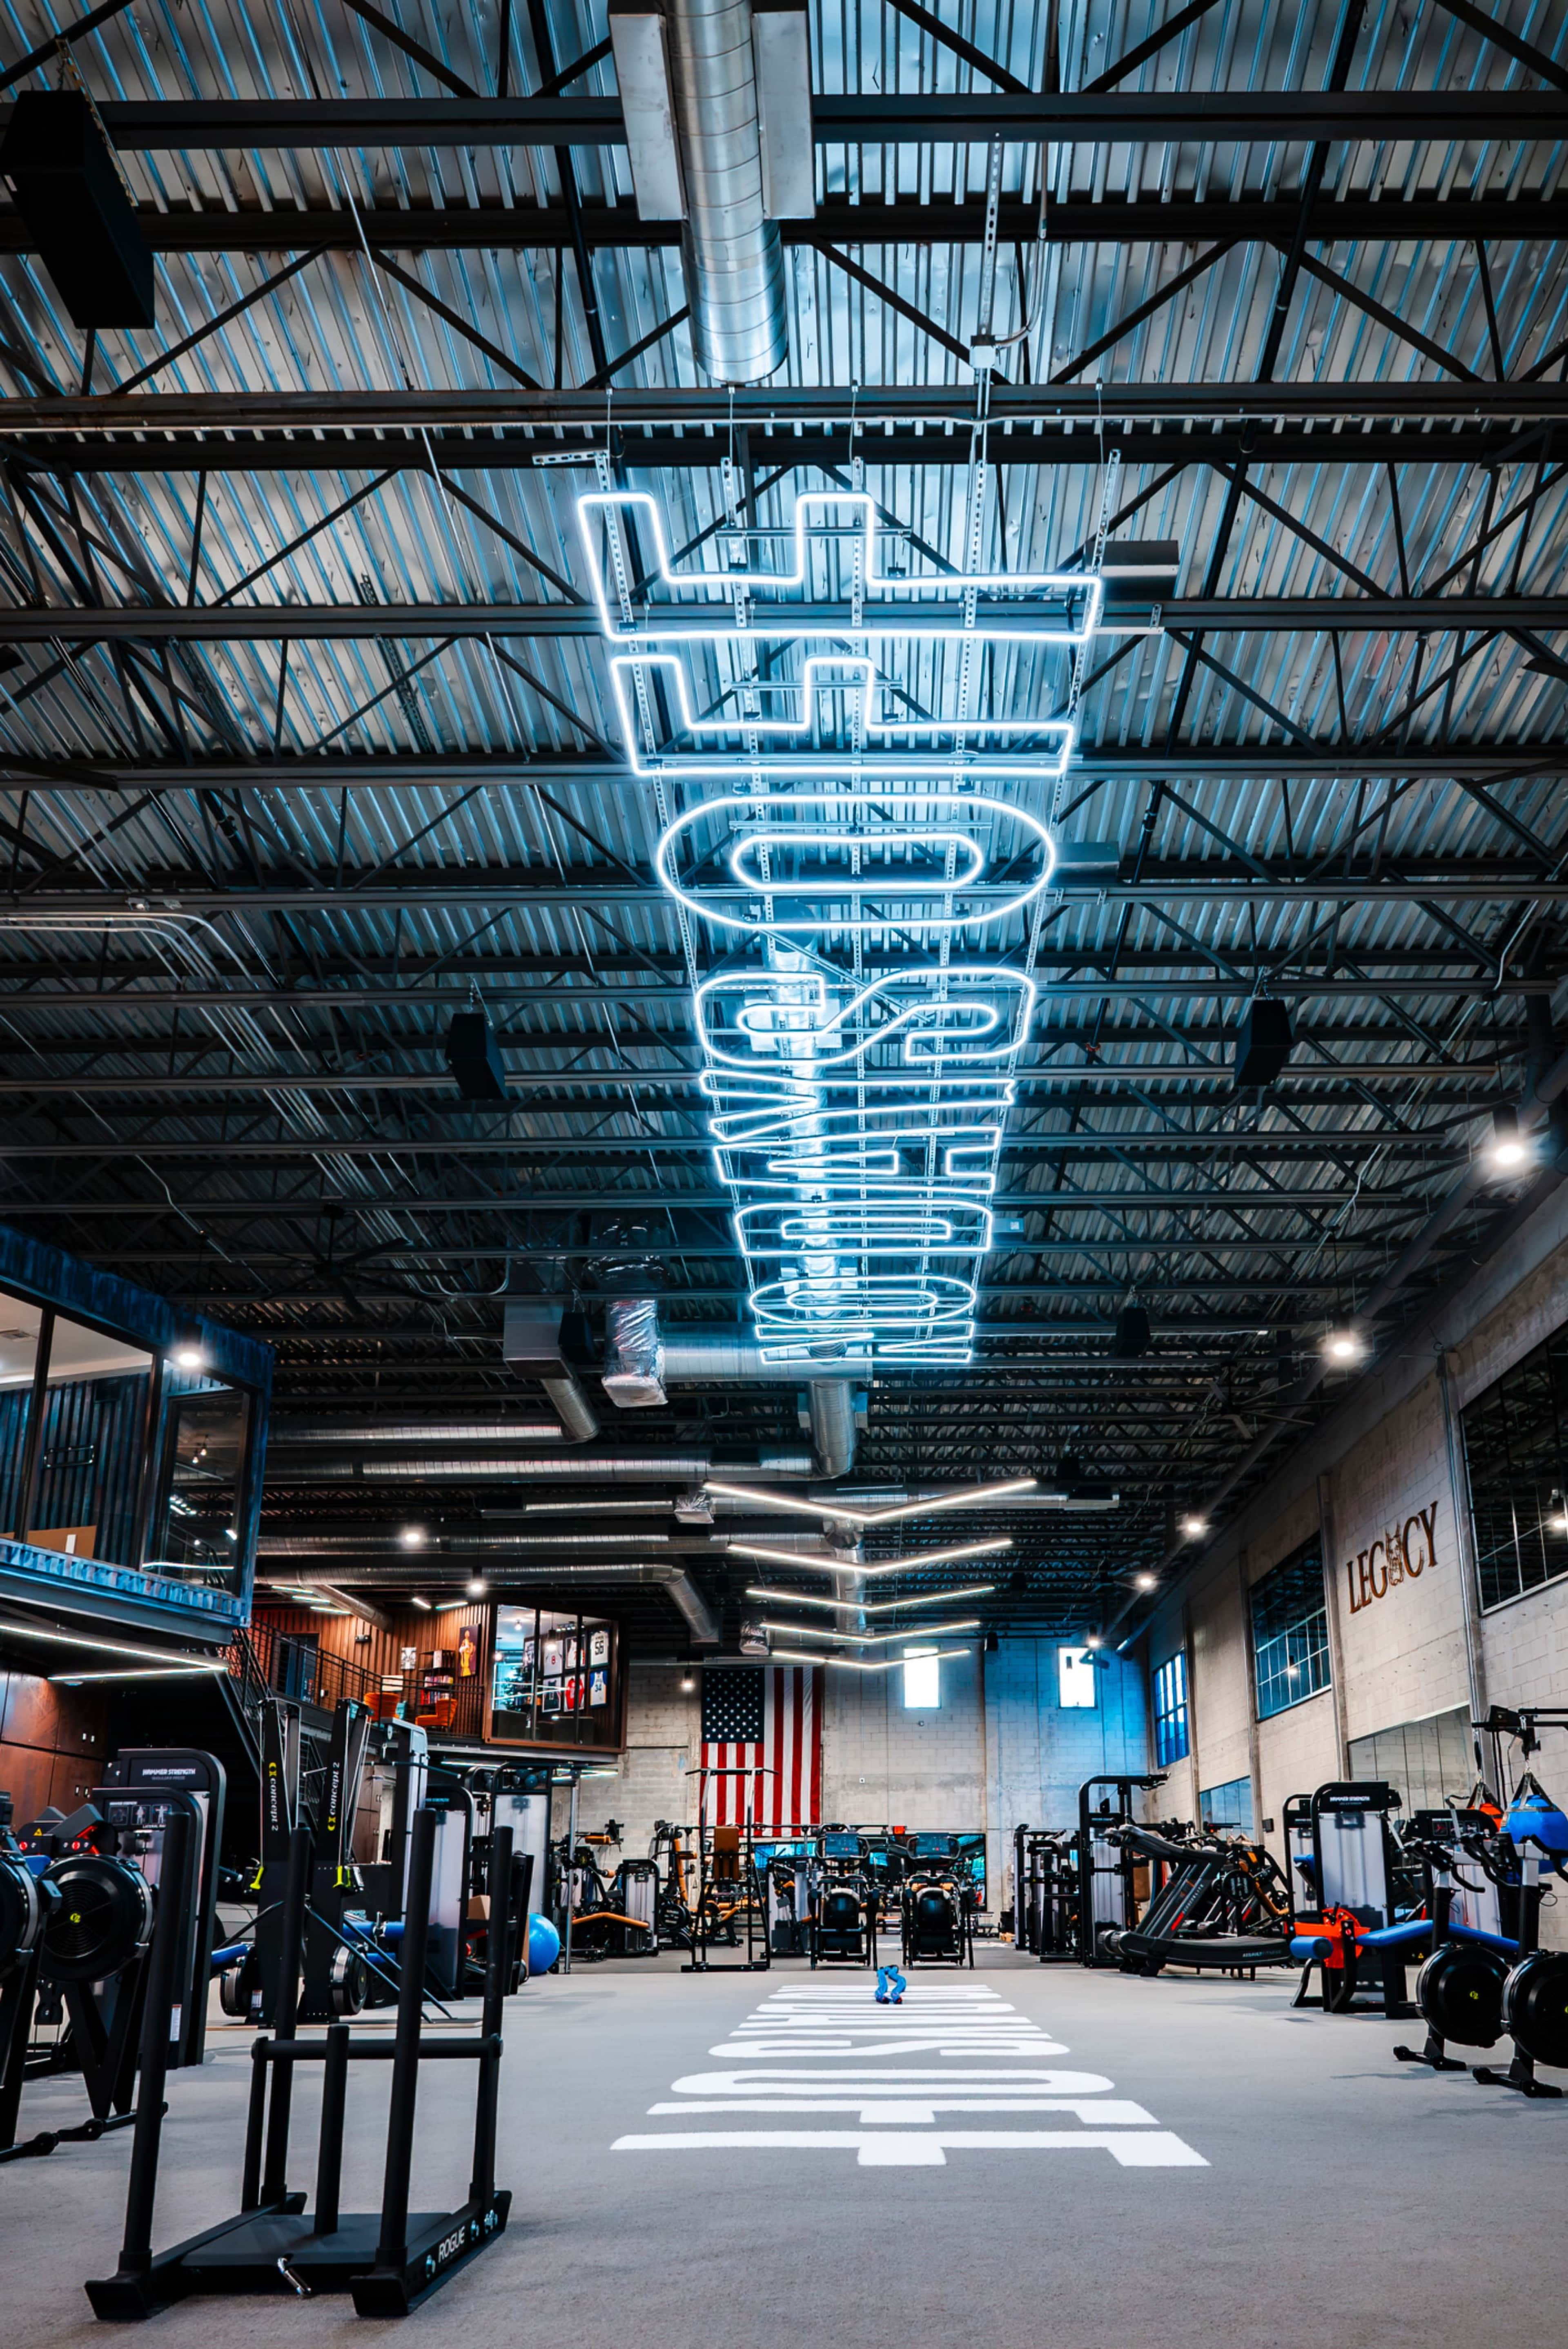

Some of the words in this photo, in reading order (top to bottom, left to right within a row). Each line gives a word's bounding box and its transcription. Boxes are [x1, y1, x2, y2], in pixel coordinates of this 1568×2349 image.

[575, 489, 1104, 931] OFF
[693, 965, 1038, 1256] DAYS
[749, 1274, 978, 1365] NO
[1347, 1500, 1439, 1614] LEGCY
[330, 1771, 339, 1816] concept
[708, 2003, 1070, 2058] DAYS
[610, 2069, 1211, 2167] OFF
[438, 2226, 465, 2263] ROGUE
